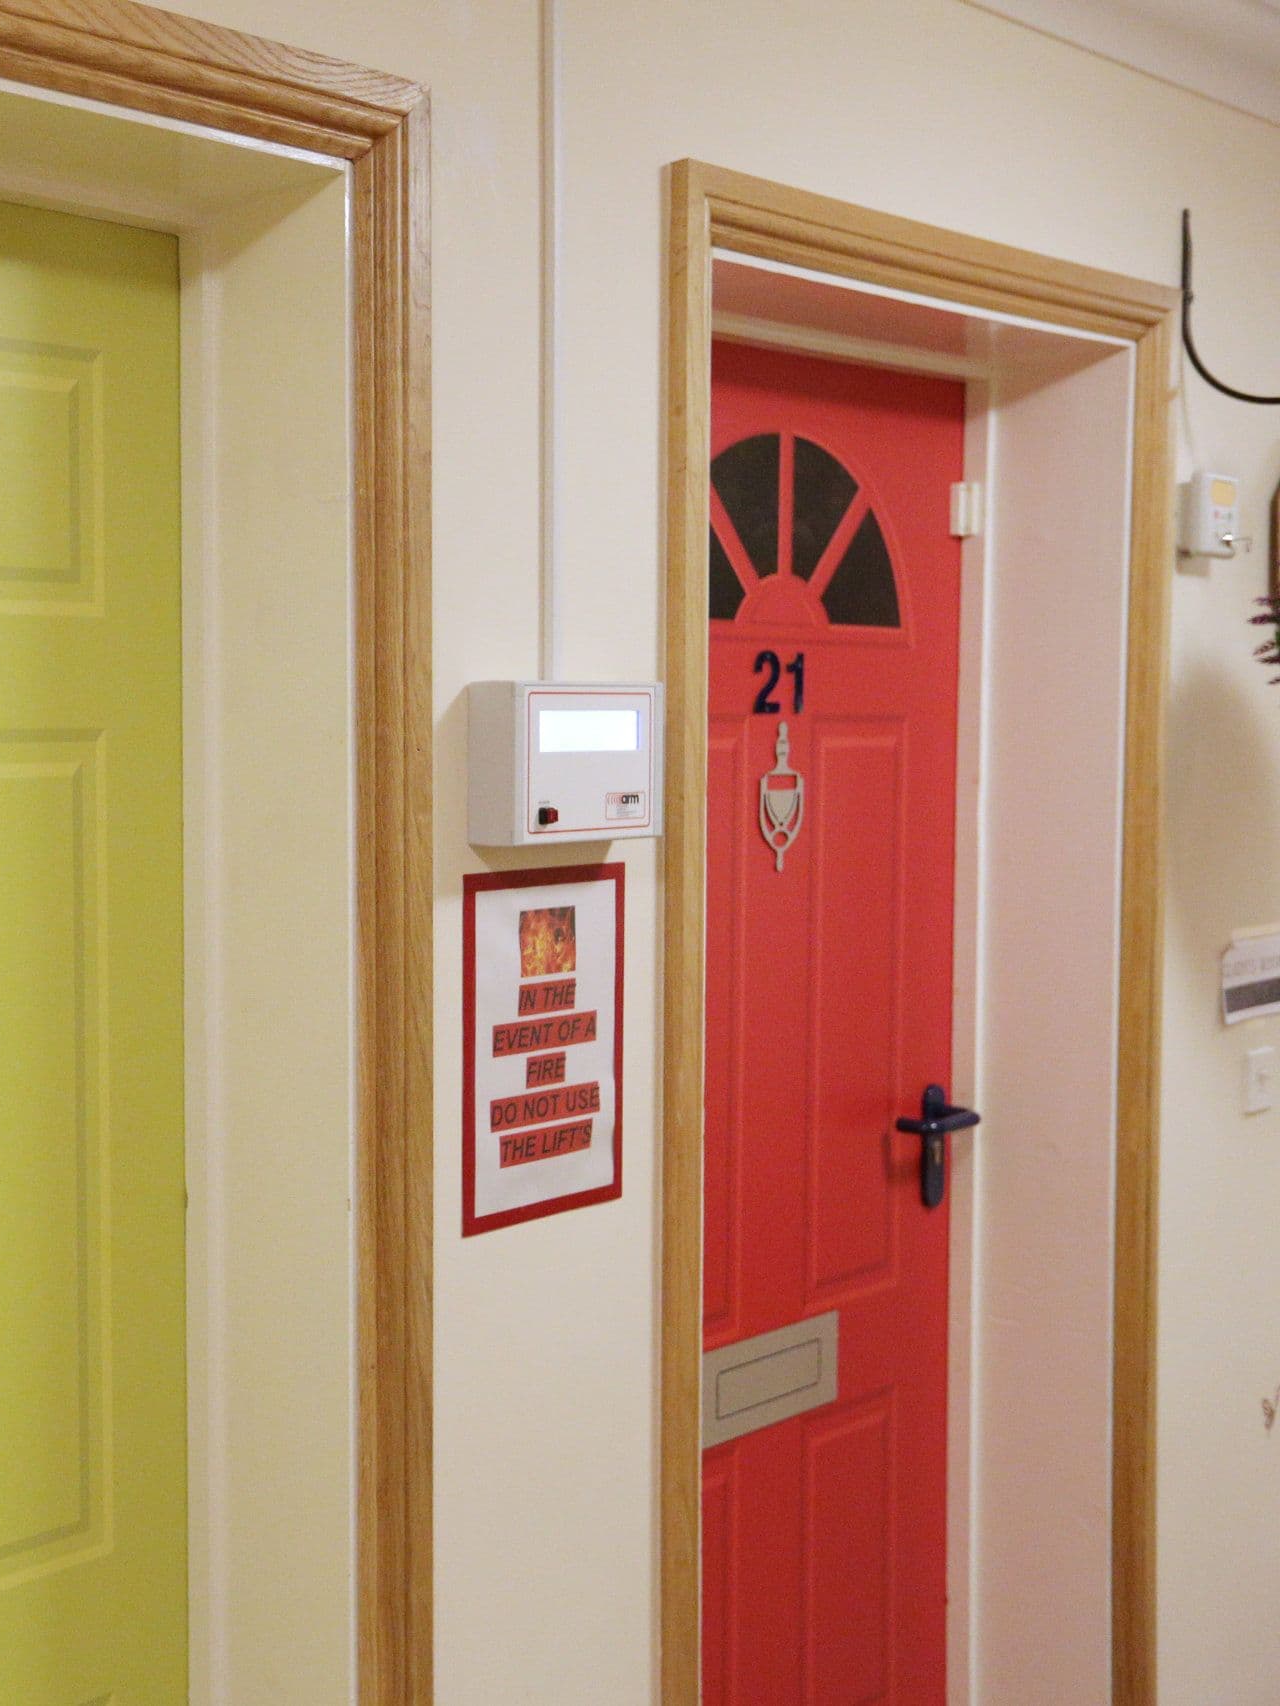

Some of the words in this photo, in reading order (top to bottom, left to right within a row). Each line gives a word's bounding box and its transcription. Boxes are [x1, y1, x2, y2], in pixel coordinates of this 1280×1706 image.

[752, 650, 804, 713] 21
[519, 989, 537, 1010] IN
[543, 984, 576, 1008] THE
[493, 1023, 553, 1051] EVENT
[558, 1019, 581, 1041] OF
[584, 1016, 596, 1037] A
[527, 1057, 566, 1084] FIRE
[491, 1102, 517, 1127] DO
[524, 1094, 560, 1120] NOT
[566, 1086, 600, 1111] USE
[501, 1135, 536, 1162] THE
[543, 1124, 592, 1153] LIFT'S
